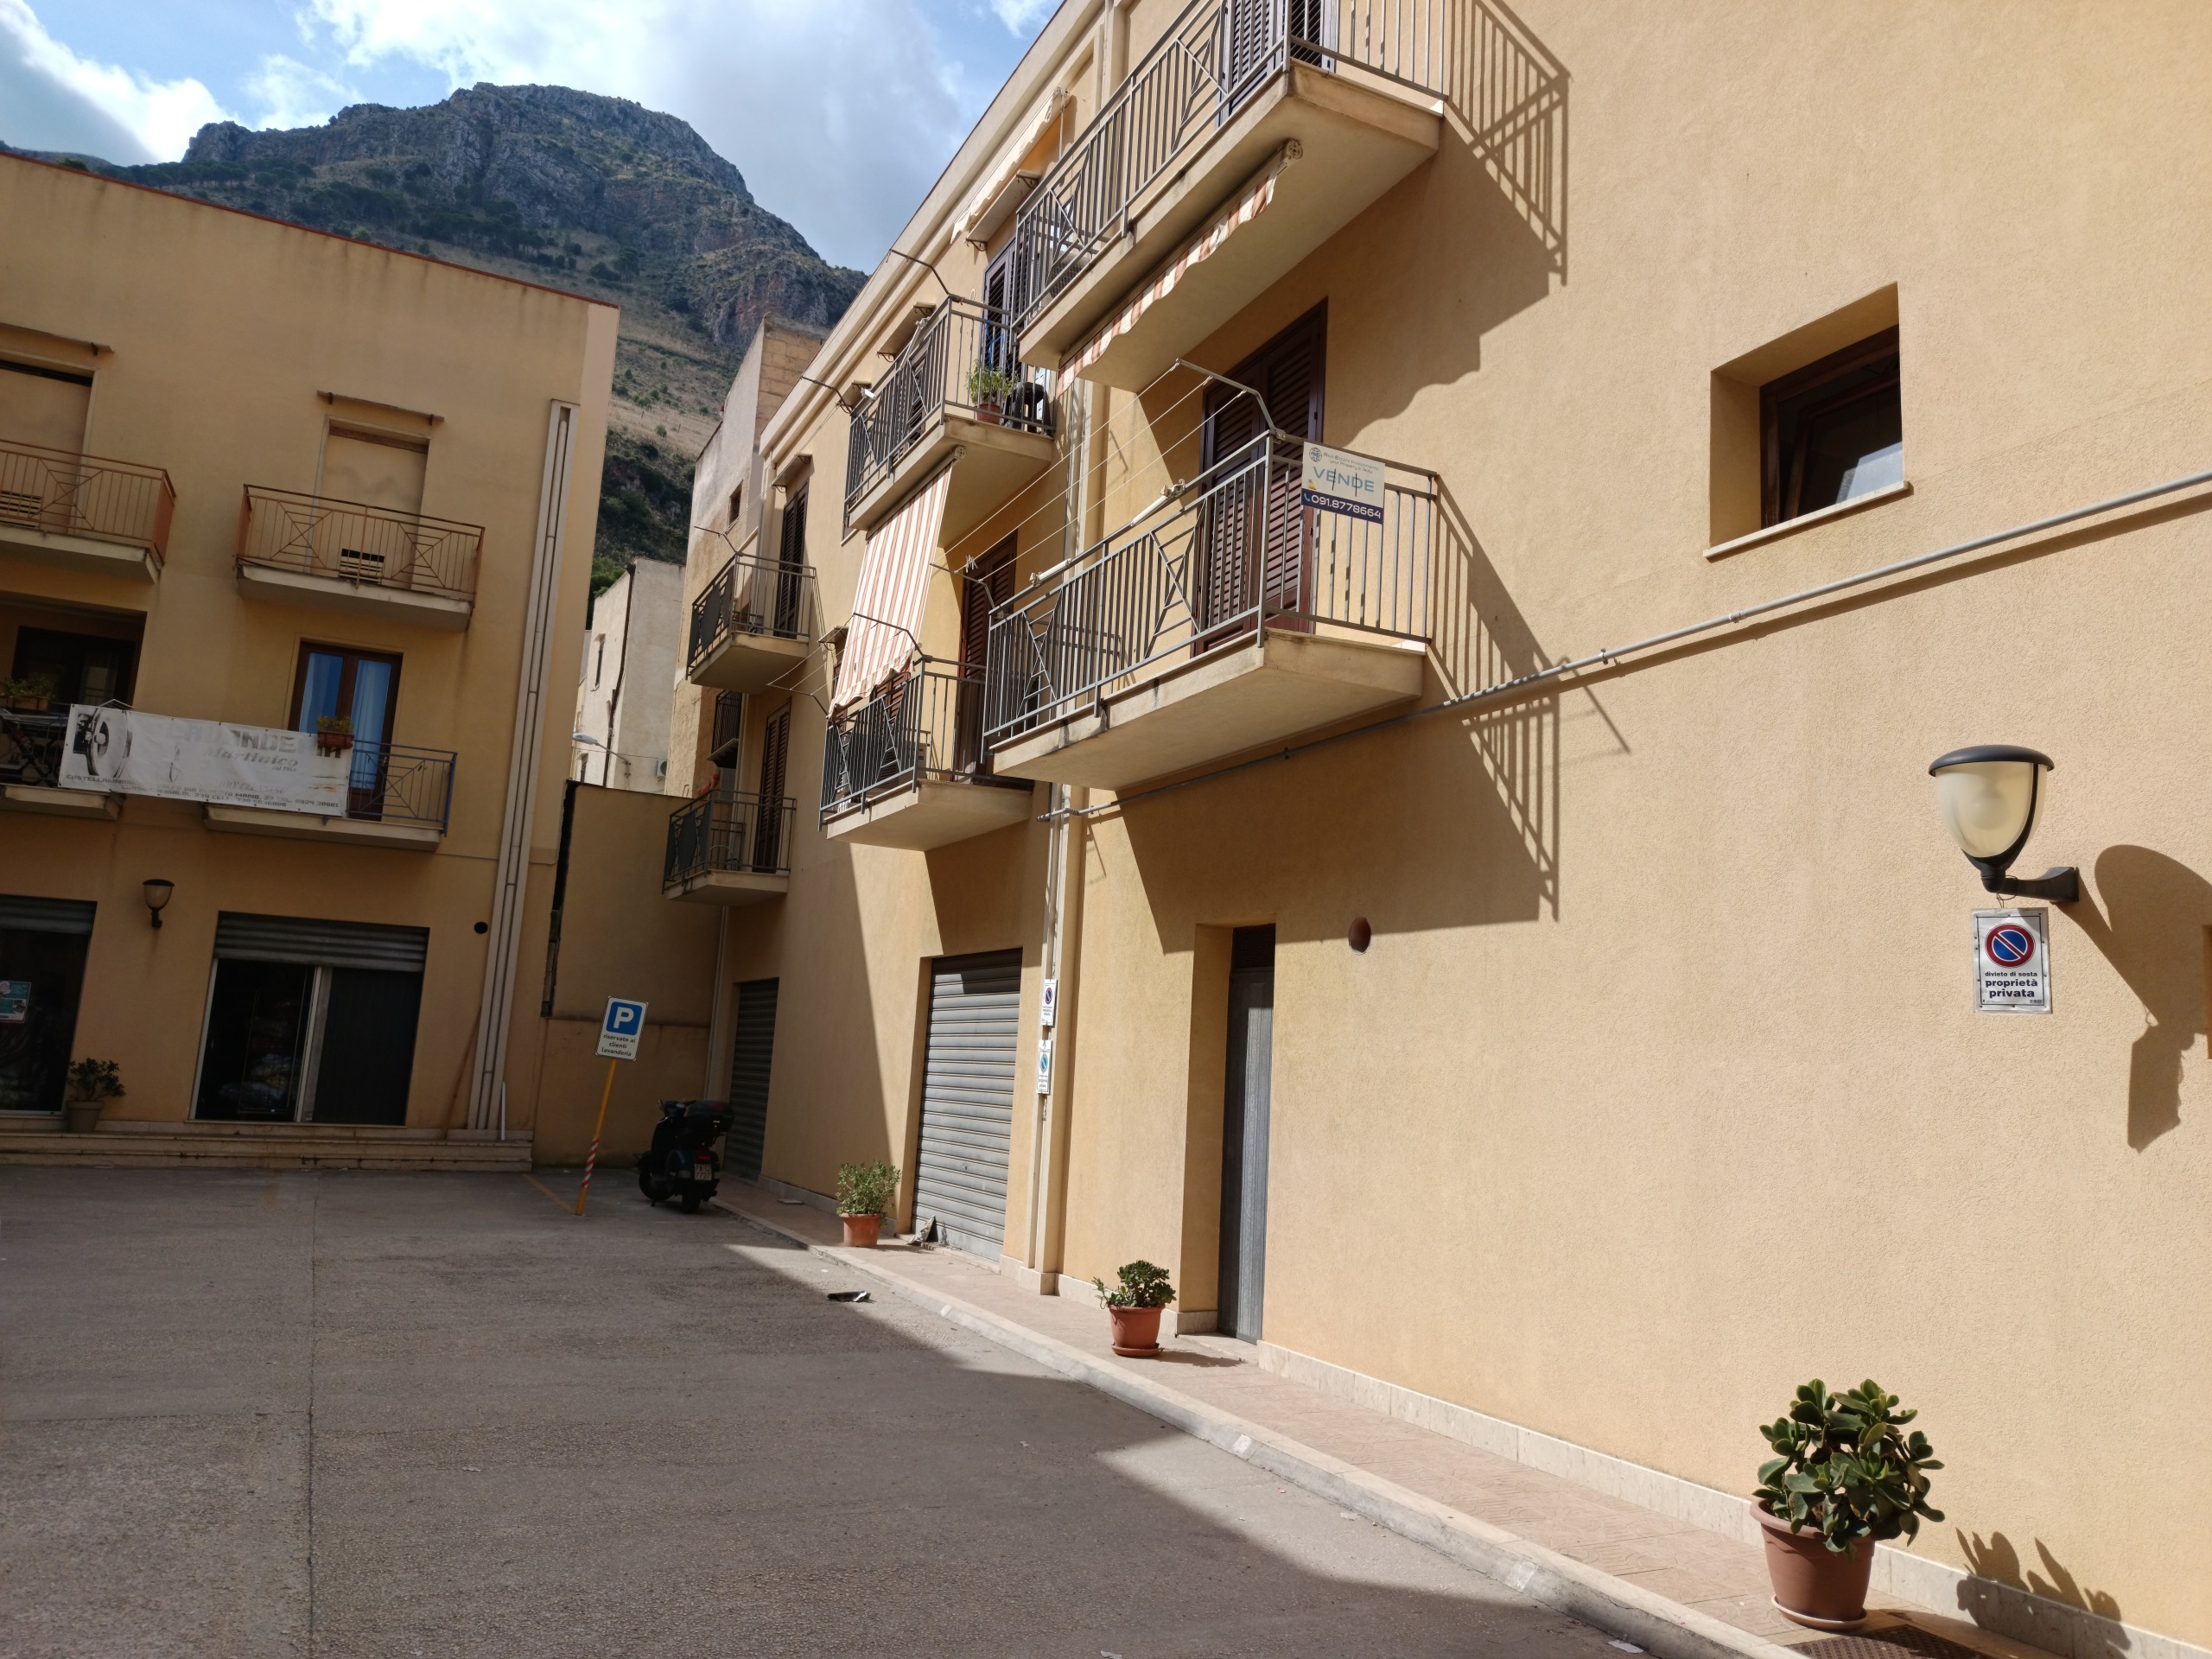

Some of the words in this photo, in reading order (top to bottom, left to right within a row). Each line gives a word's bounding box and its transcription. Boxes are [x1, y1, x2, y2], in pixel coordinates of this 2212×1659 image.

[1313, 467, 1374, 492] VENDE
[1312, 495, 1380, 518] 091.8778664
[1985, 978, 2038, 988] proprietà
[1989, 988, 2035, 999] privata
[613, 1007, 634, 1029] P
[603, 1033, 629, 1042] riservato
[601, 1047, 632, 1057] lavanderia
